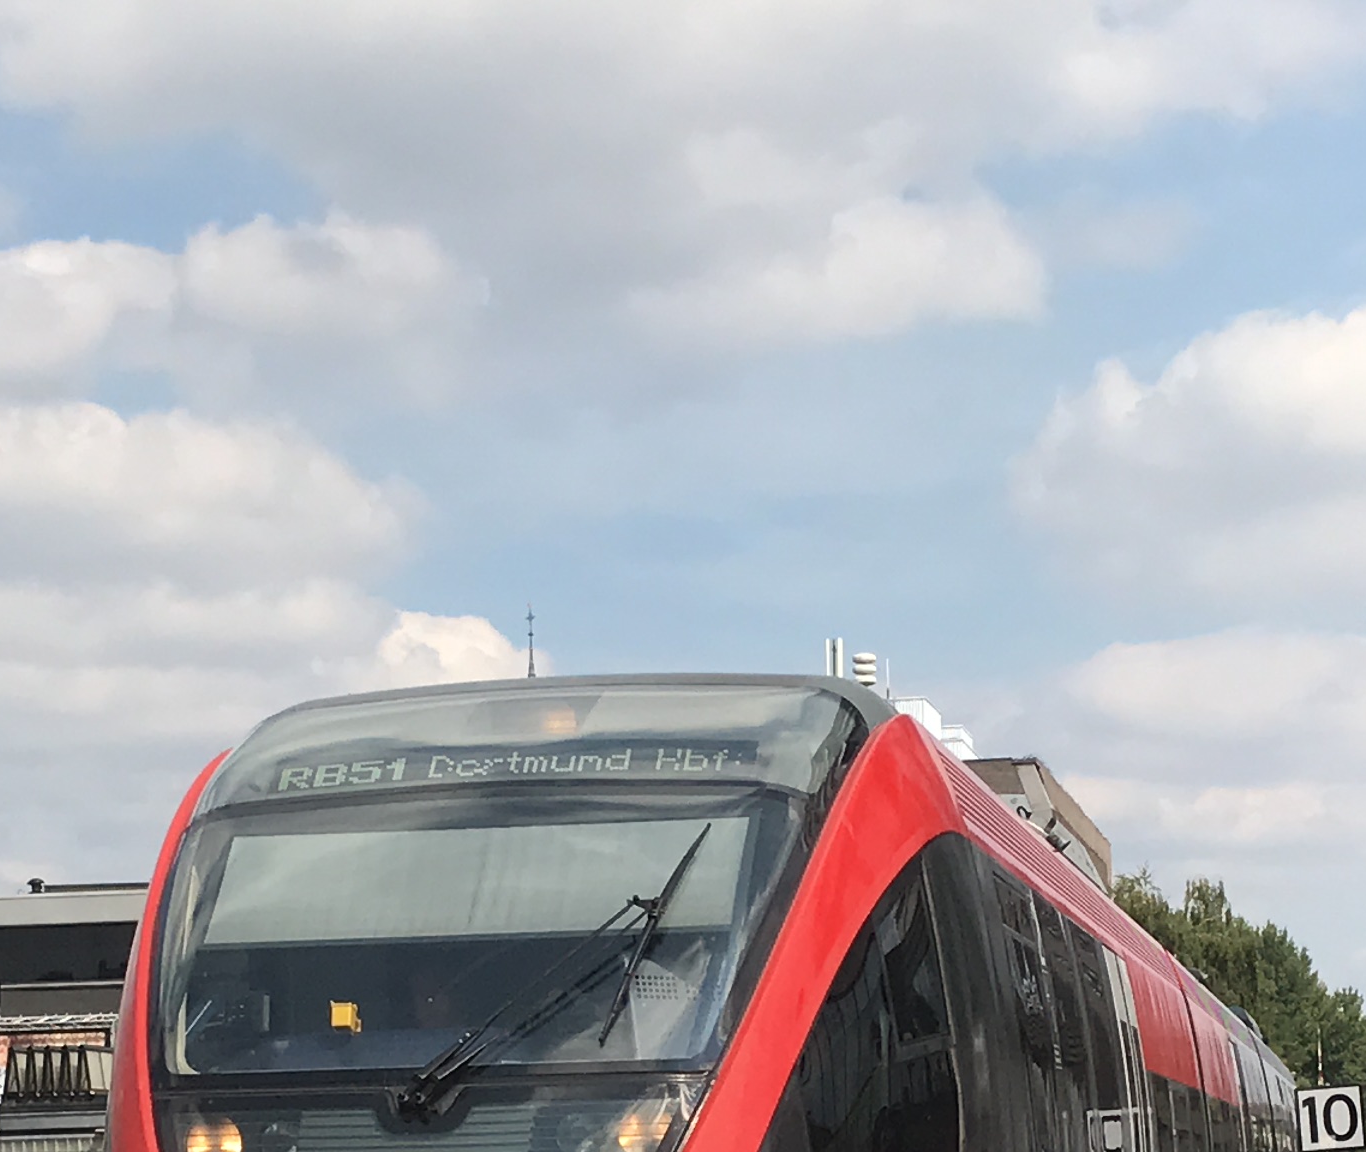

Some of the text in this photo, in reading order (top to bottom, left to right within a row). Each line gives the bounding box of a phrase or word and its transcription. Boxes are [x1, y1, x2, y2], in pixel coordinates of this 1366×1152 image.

[278, 758, 407, 791] RB51
[428, 748, 632, 779] Dortmund
[1302, 1093, 1359, 1144] 10
